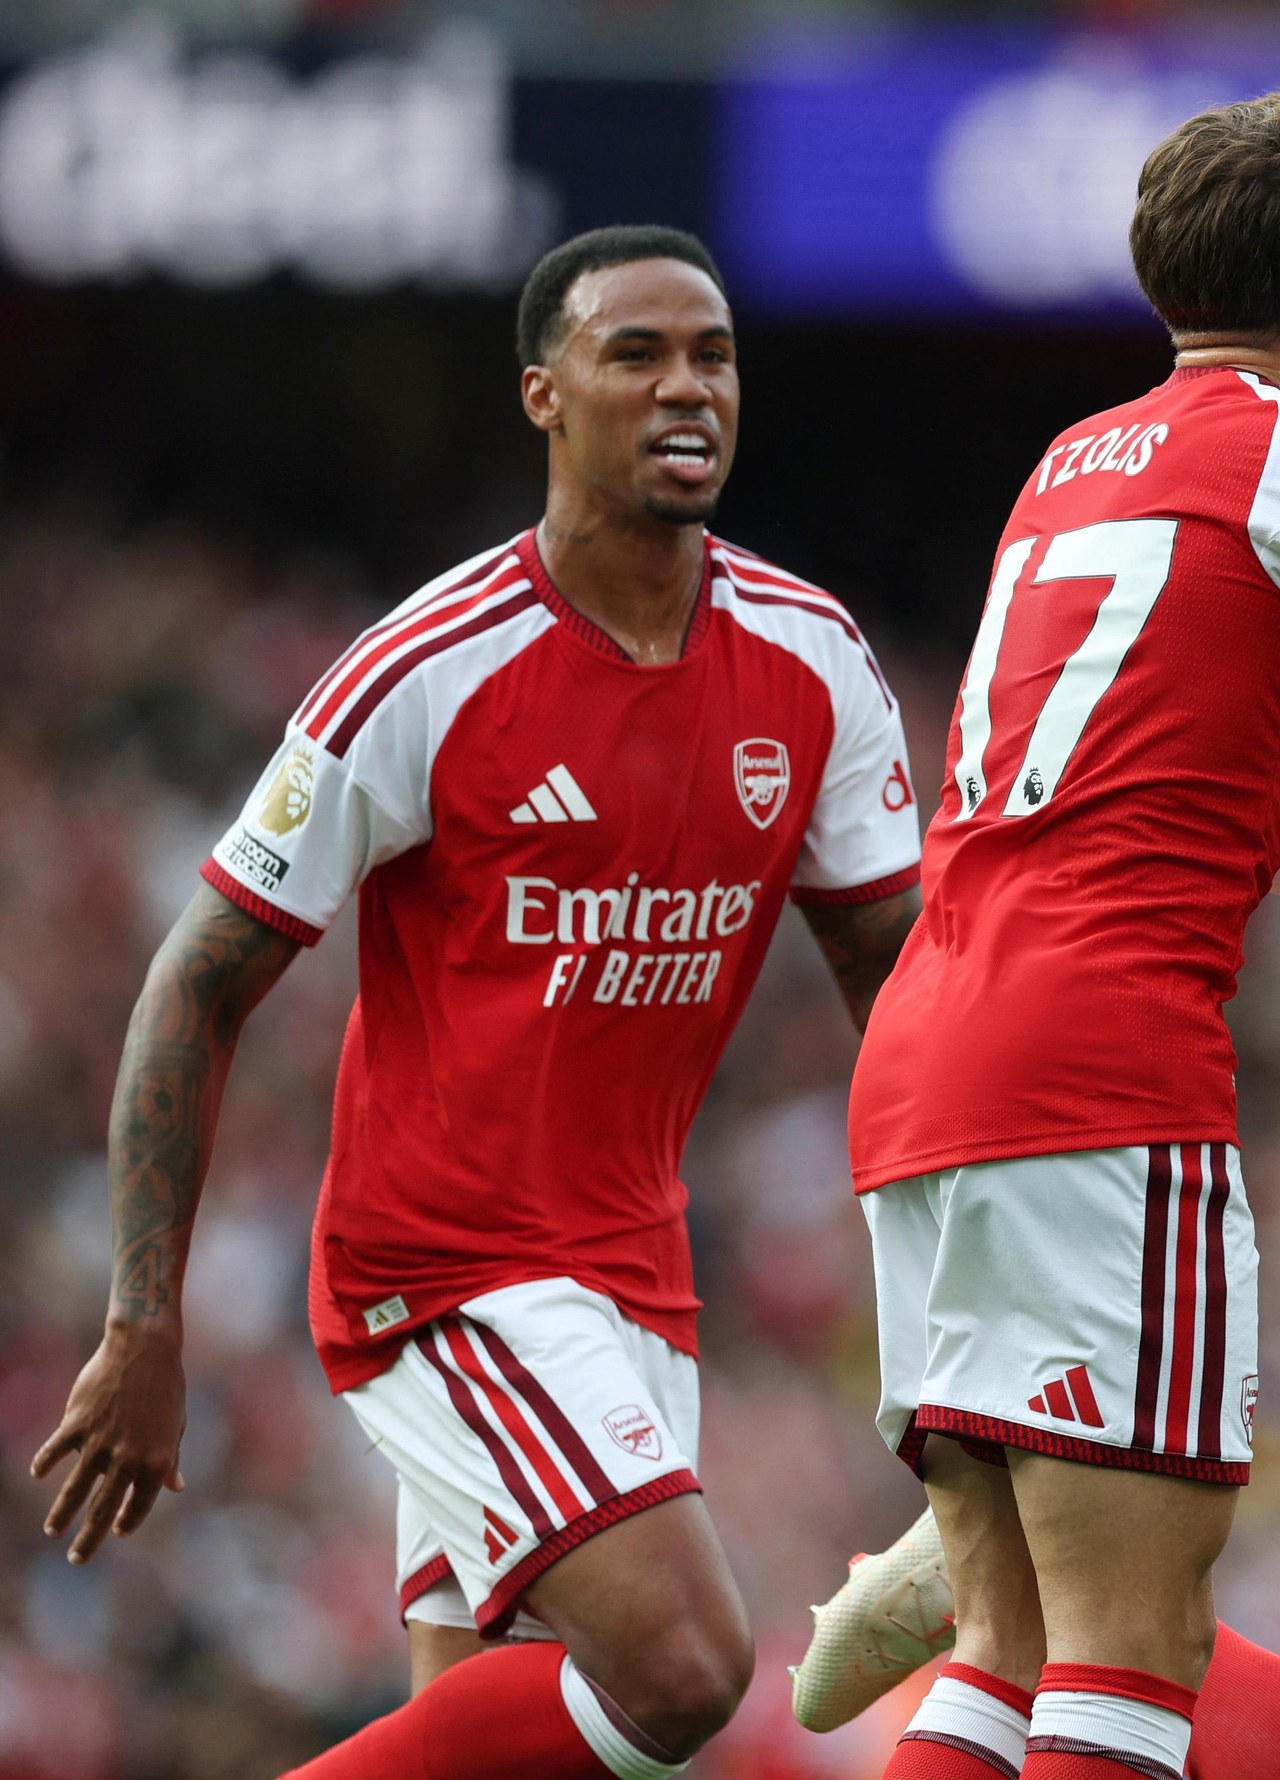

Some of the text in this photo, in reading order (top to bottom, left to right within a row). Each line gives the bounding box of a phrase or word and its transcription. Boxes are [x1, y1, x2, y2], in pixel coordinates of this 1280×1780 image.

[1035, 422, 1170, 498] TZOLIS
[953, 518, 1180, 823] 17
[230, 848, 281, 893] racism
[239, 835, 281, 876] room
[504, 871, 763, 945] Emirates
[592, 949, 723, 1007] BETTER
